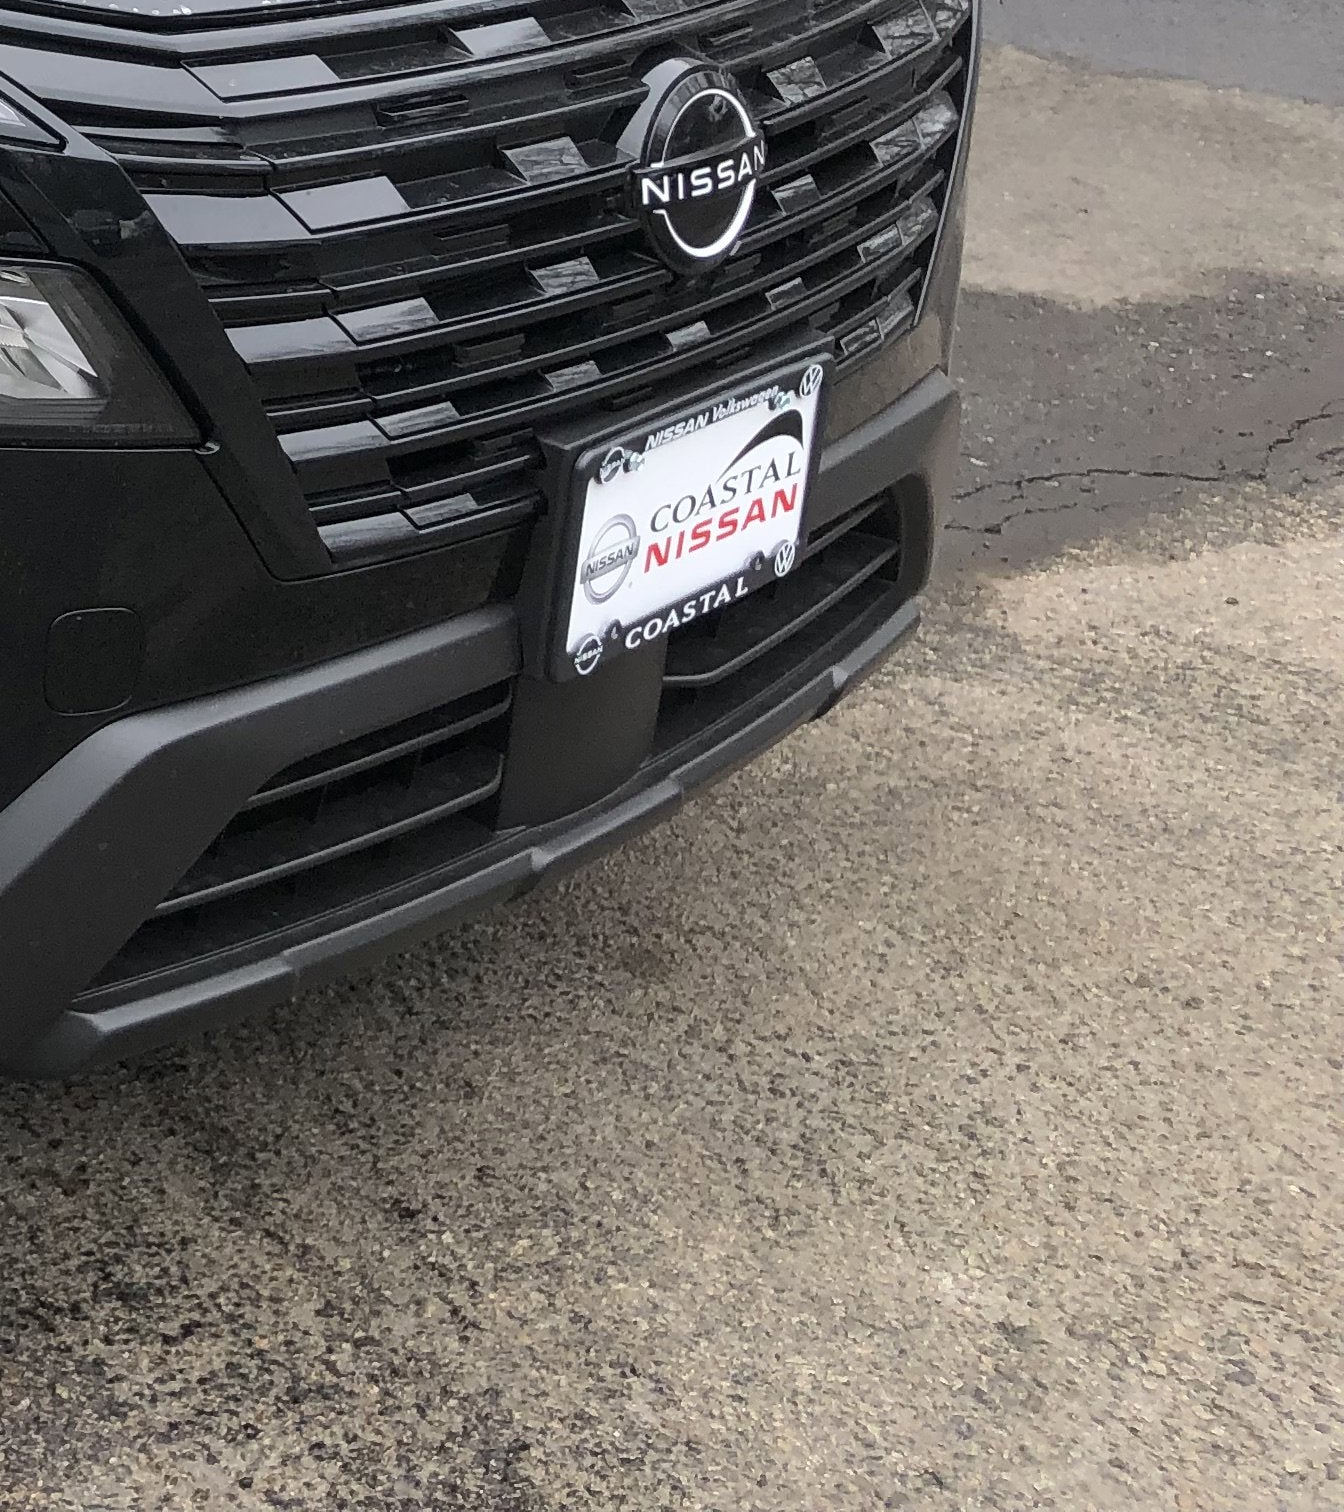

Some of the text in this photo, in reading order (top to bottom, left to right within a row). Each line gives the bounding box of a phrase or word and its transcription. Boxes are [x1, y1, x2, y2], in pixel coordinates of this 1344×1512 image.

[641, 139, 766, 206] NISSAN
[645, 385, 779, 453] NISSAN Volkswagen
[644, 482, 798, 574] NISSAN
[650, 452, 802, 534] COASTAL
[585, 541, 635, 577] NISSAN
[624, 576, 749, 650] COASTAL
